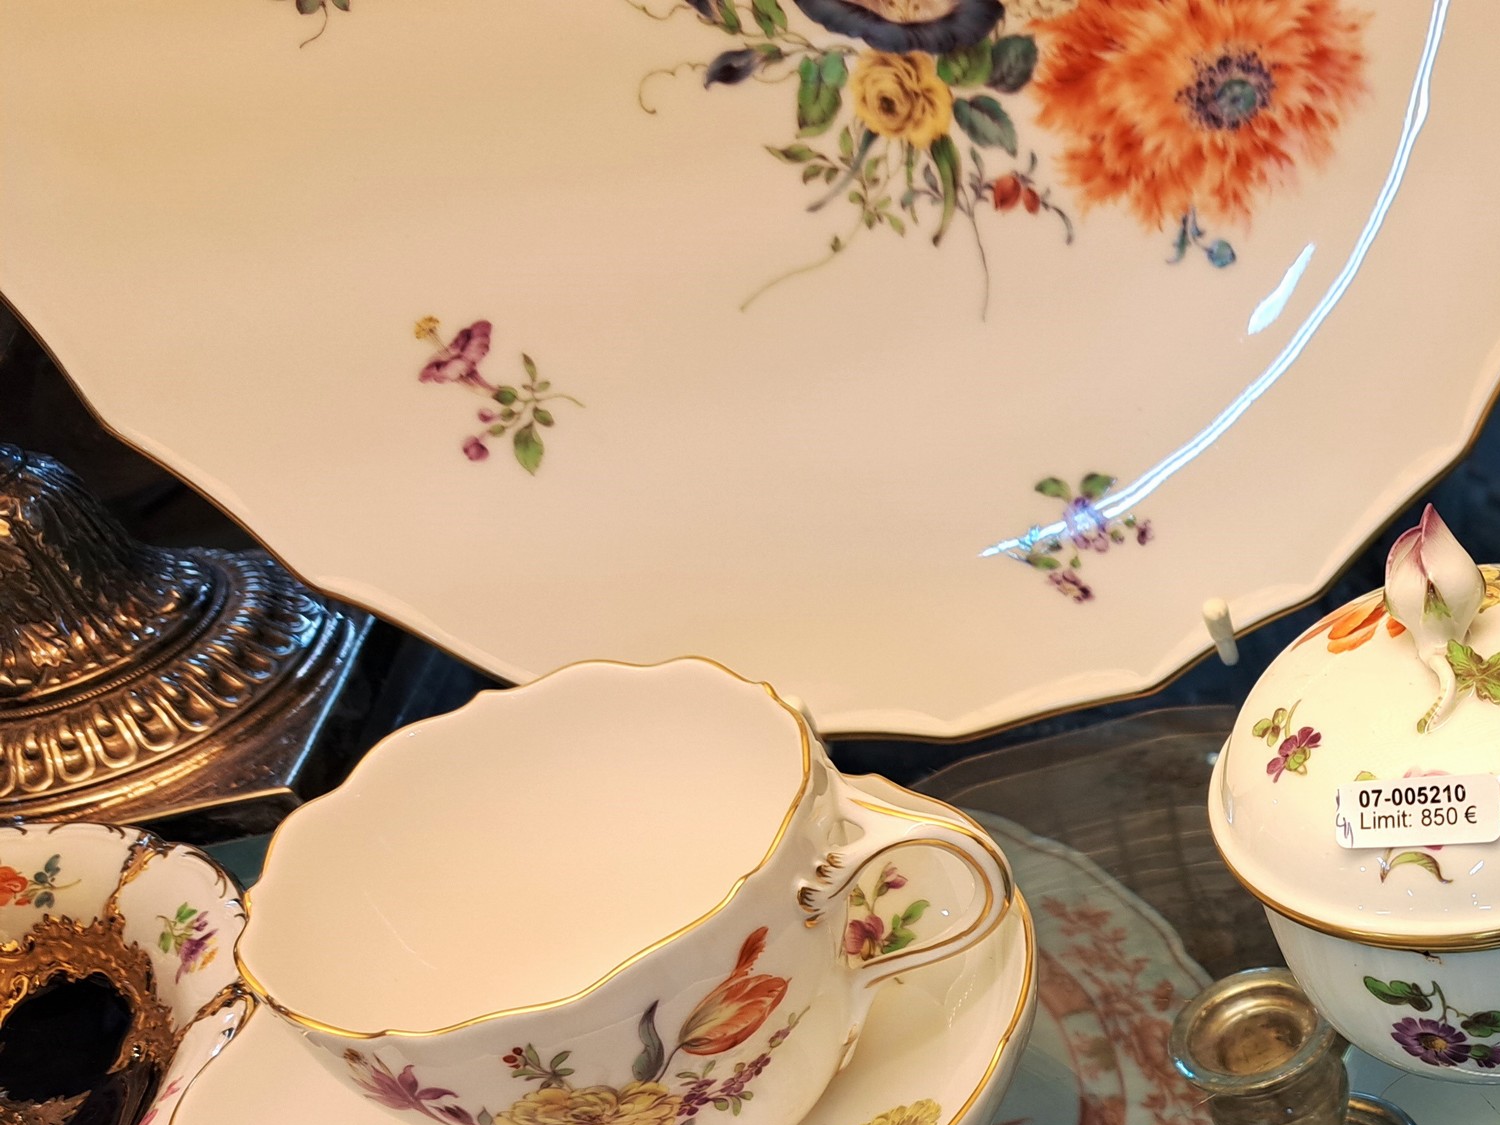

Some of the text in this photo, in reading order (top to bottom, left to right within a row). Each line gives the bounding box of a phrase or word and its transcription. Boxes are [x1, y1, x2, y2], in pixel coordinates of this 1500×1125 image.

[1359, 784, 1466, 808] 07-005210
[1360, 805, 1477, 830] Limit: 850 €
